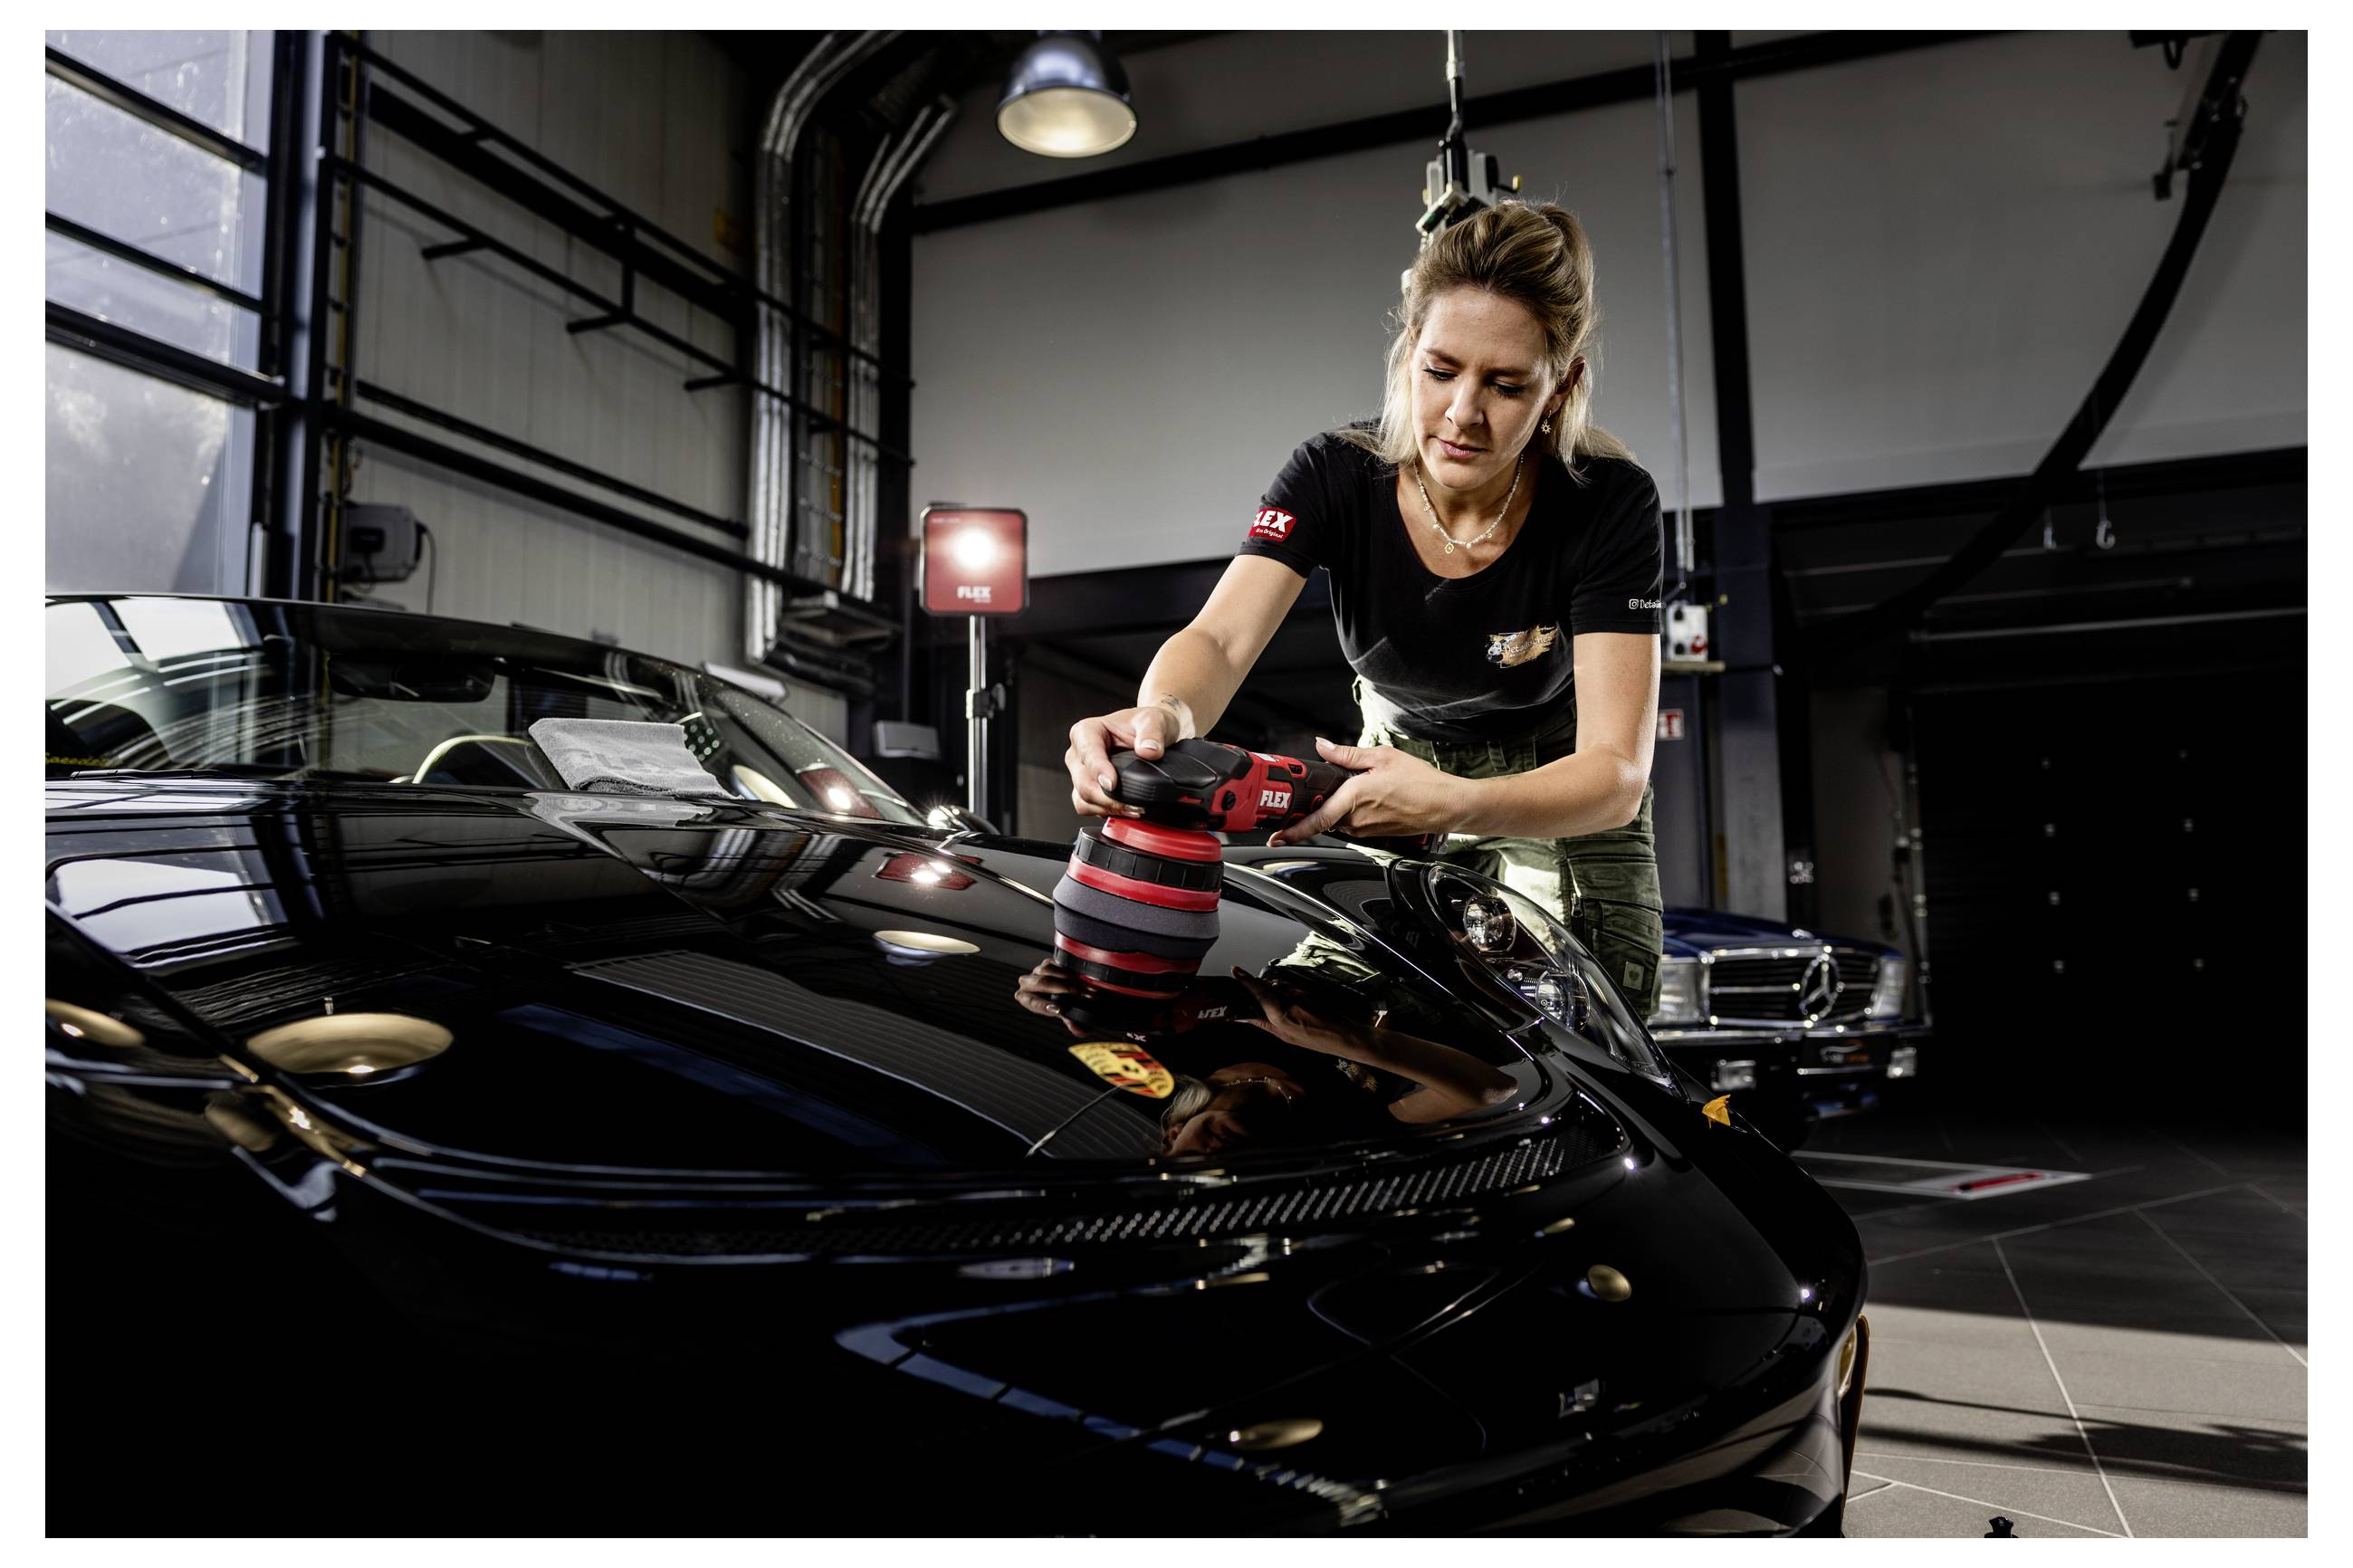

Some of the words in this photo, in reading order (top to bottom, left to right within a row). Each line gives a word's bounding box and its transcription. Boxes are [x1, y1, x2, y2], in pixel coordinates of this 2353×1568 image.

[1252, 510, 1294, 533] LEX
[956, 585, 992, 599] FLEX
[1259, 789, 1291, 808] FLEX
